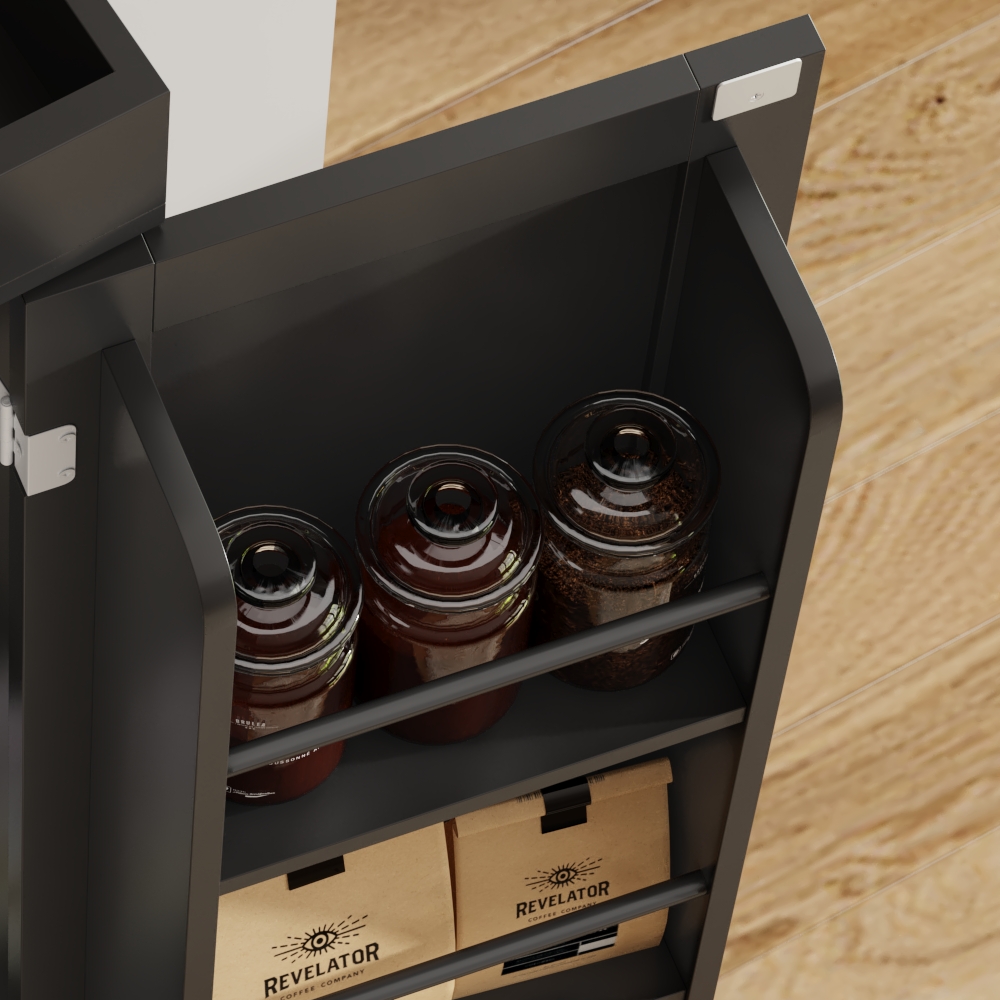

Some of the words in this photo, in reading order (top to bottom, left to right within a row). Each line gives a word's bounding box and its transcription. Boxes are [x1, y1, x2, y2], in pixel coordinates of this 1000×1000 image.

[516, 880, 610, 919] REVELATOR
[528, 911, 557, 923] COFFEE
[264, 942, 379, 999] REVELATOR
[320, 968, 365, 988] COMPANY
